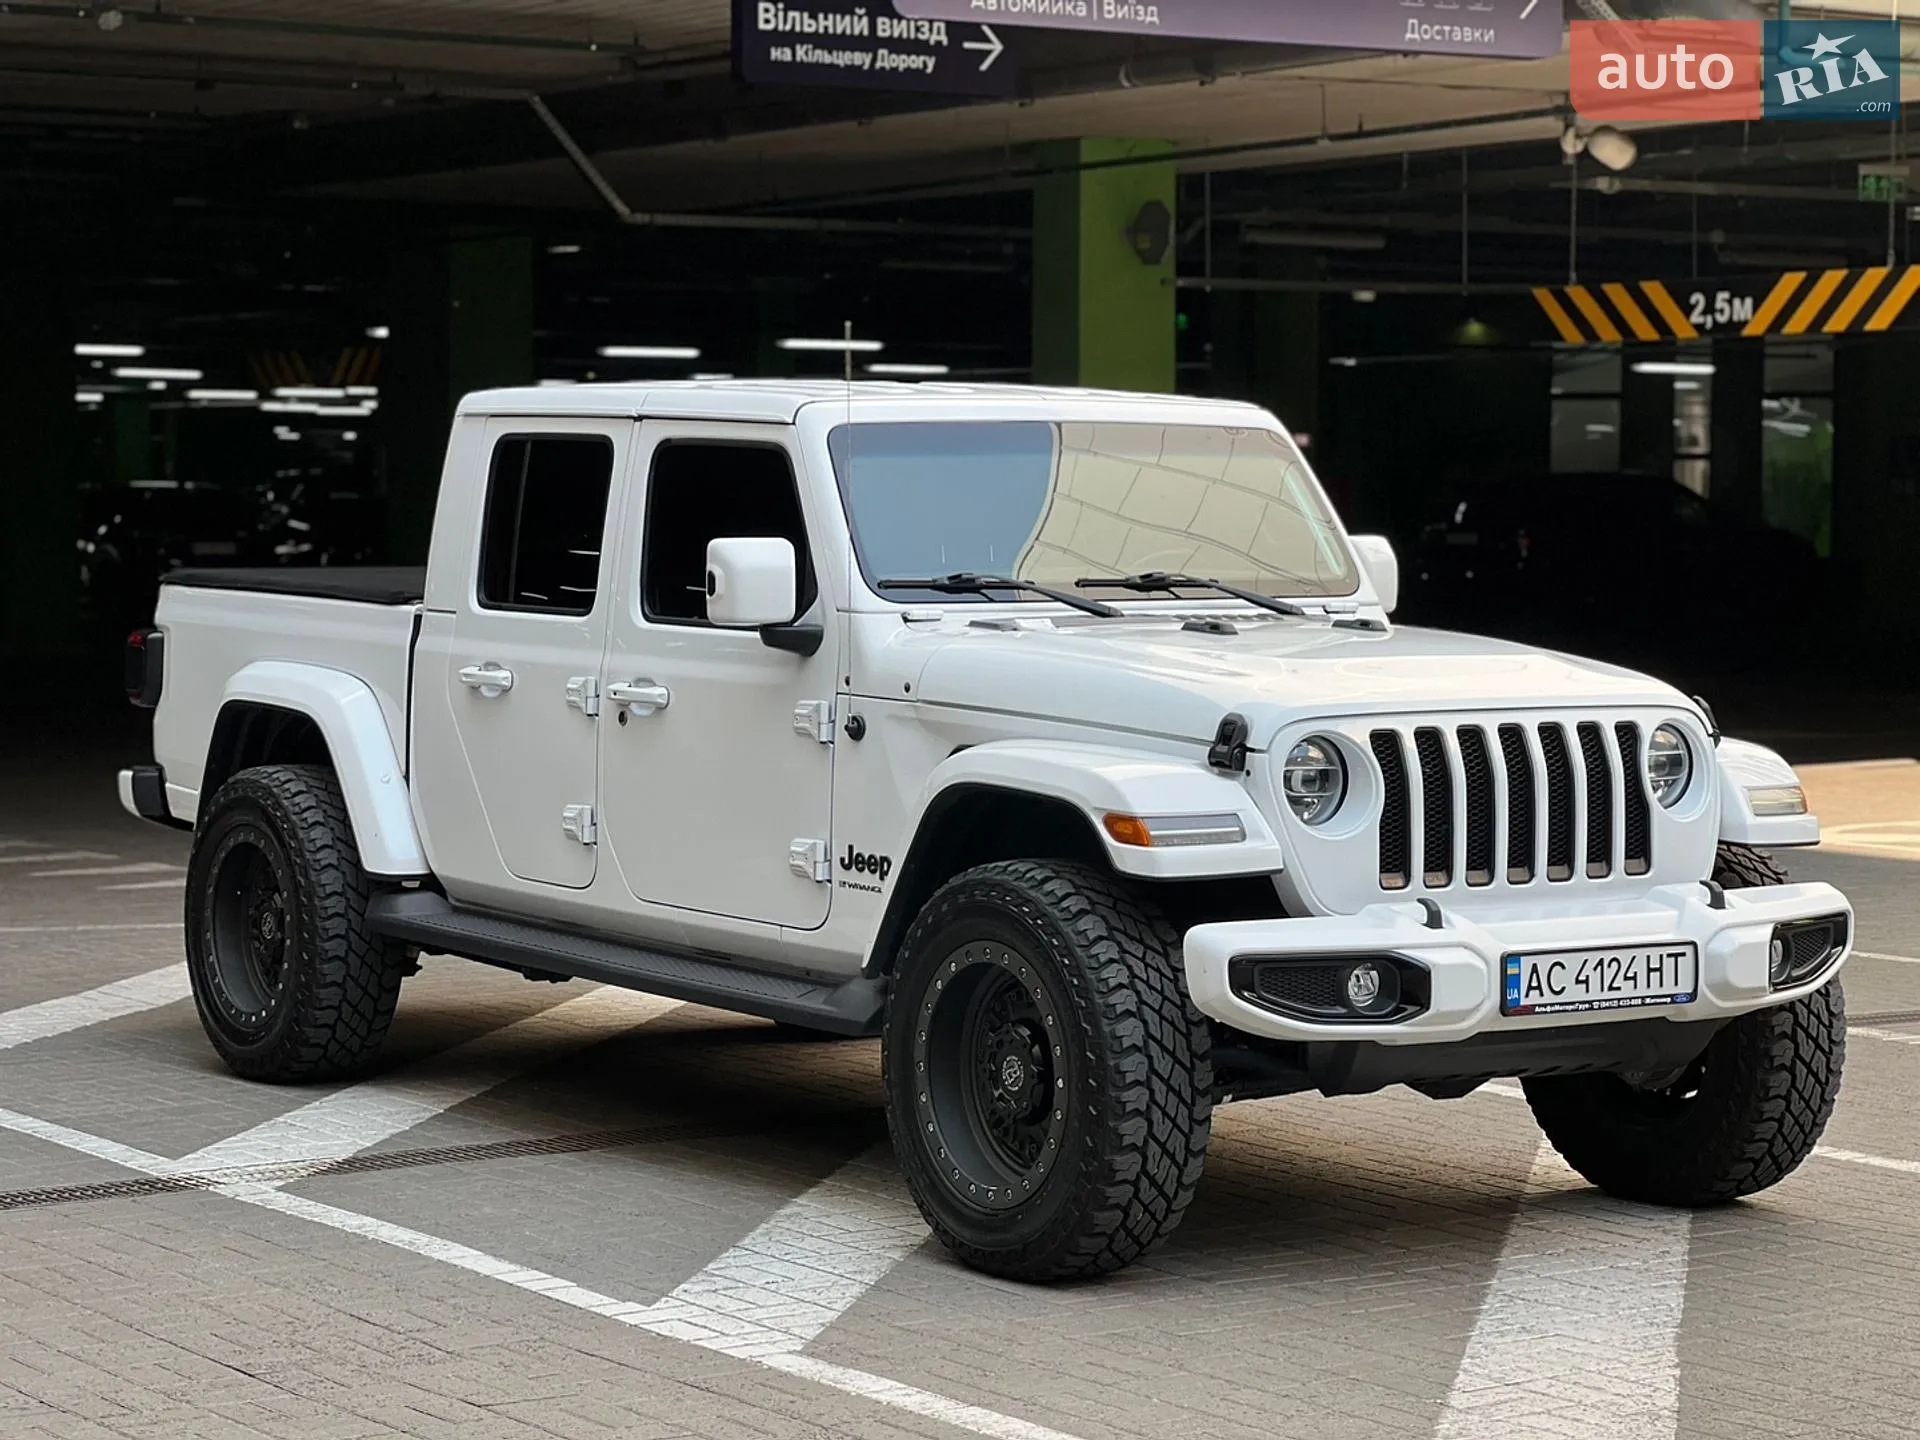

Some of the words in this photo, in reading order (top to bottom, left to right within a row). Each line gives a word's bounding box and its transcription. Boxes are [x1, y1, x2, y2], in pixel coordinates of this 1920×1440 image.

[757, 1, 869, 36] Вільний
[1404, 18, 1496, 43] Доставки
[769, 46, 793, 62] на
[795, 43, 872, 70] Кільцеву
[875, 48, 936, 74] Дорогу
[839, 844, 892, 881] Jeep
[1524, 961, 1566, 998] AC
[1574, 955, 1637, 994] 4124
[1646, 952, 1686, 989] HT
[1506, 988, 1519, 1000] UA
